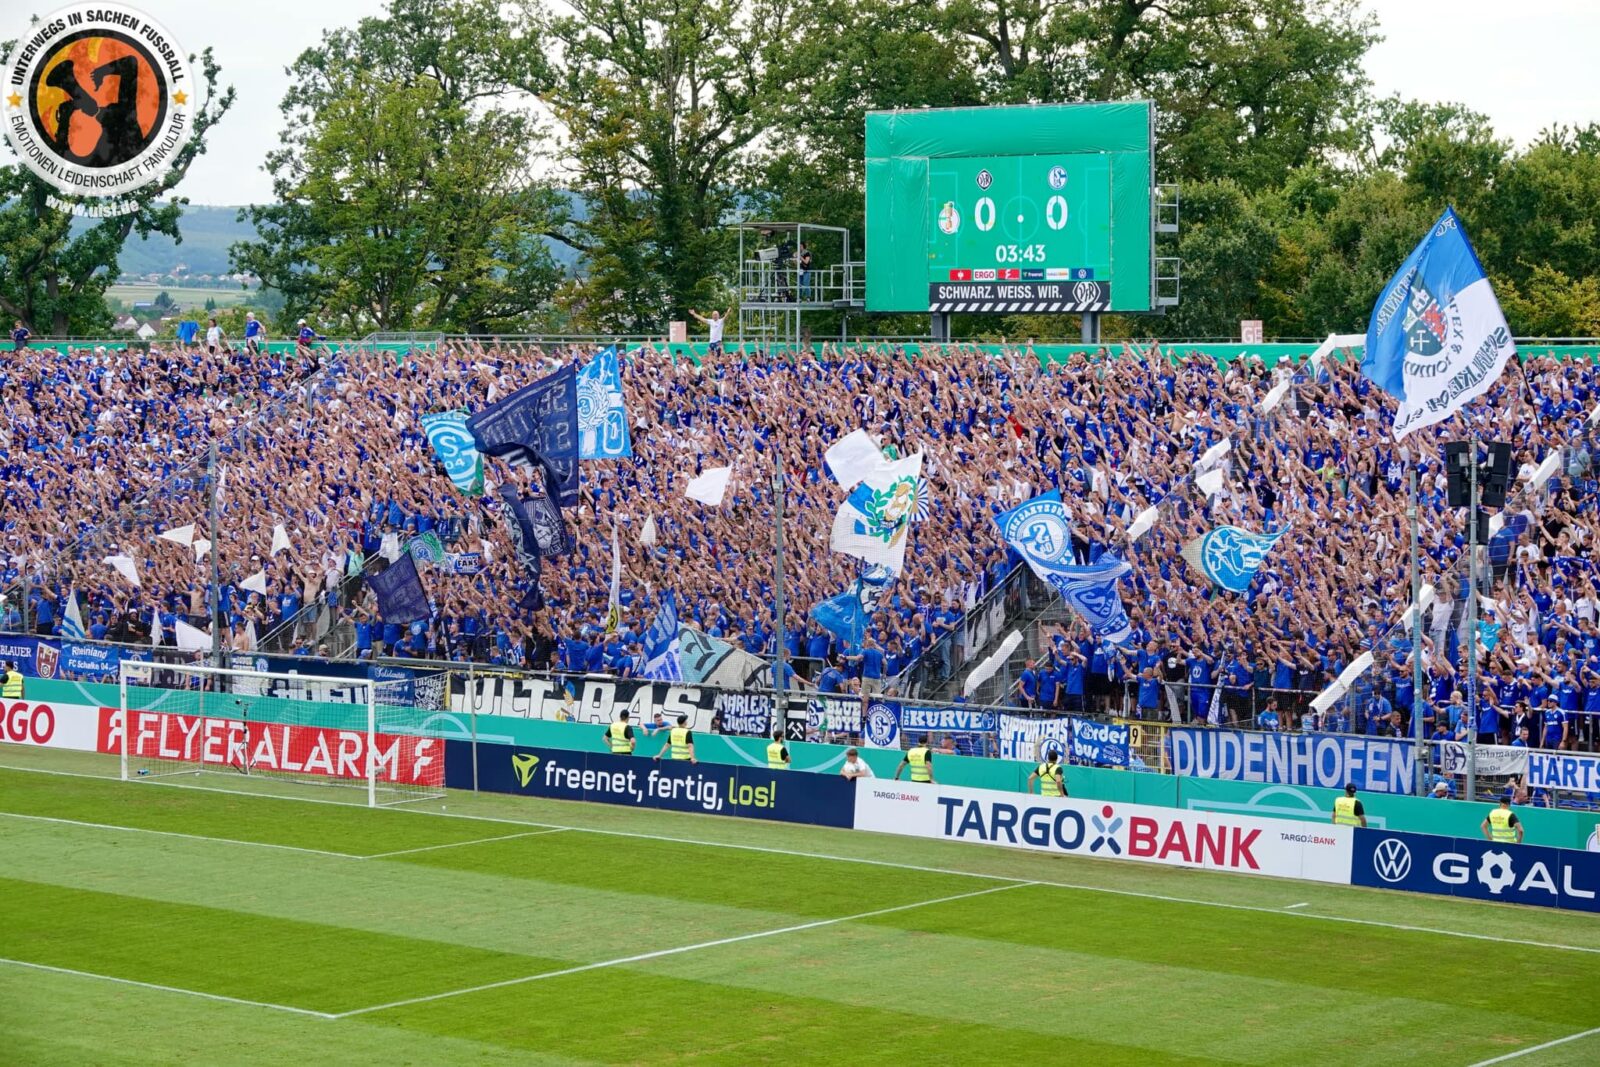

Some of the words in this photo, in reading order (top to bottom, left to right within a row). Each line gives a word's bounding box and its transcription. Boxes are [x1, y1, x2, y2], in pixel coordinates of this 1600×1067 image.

[974, 196, 996, 232] 0
[1046, 194, 1068, 231] 0
[995, 244, 1046, 263] 03:43
[974, 270, 995, 279] ERGO
[939, 285, 995, 300] SCHWARZ.
[997, 285, 1035, 299] WEISS.
[1037, 284, 1063, 299] WIR.
[457, 559, 478, 567] FANS
[72, 646, 108, 659] Rheinland
[69, 659, 77, 667] FC
[77, 660, 100, 670] Schalke
[100, 662, 109, 671] 04
[827, 700, 861, 716] BLUE
[0, 702, 55, 745] GO
[722, 714, 768, 734] JUNGS
[827, 715, 861, 732] BOYZ
[910, 710, 983, 729] KURVE
[1000, 713, 1069, 743] SUPPORTERS
[1132, 727, 1139, 745] 9
[137, 713, 400, 781] FLYERALARM
[1000, 740, 1038, 762] CLUB
[1074, 738, 1100, 760] bus
[1171, 730, 1415, 793] DUDENHOFEN
[545, 760, 644, 803] freenet,
[648, 770, 724, 811] fertig,
[728, 777, 777, 809] los!
[1433, 849, 1596, 900] GOAL
